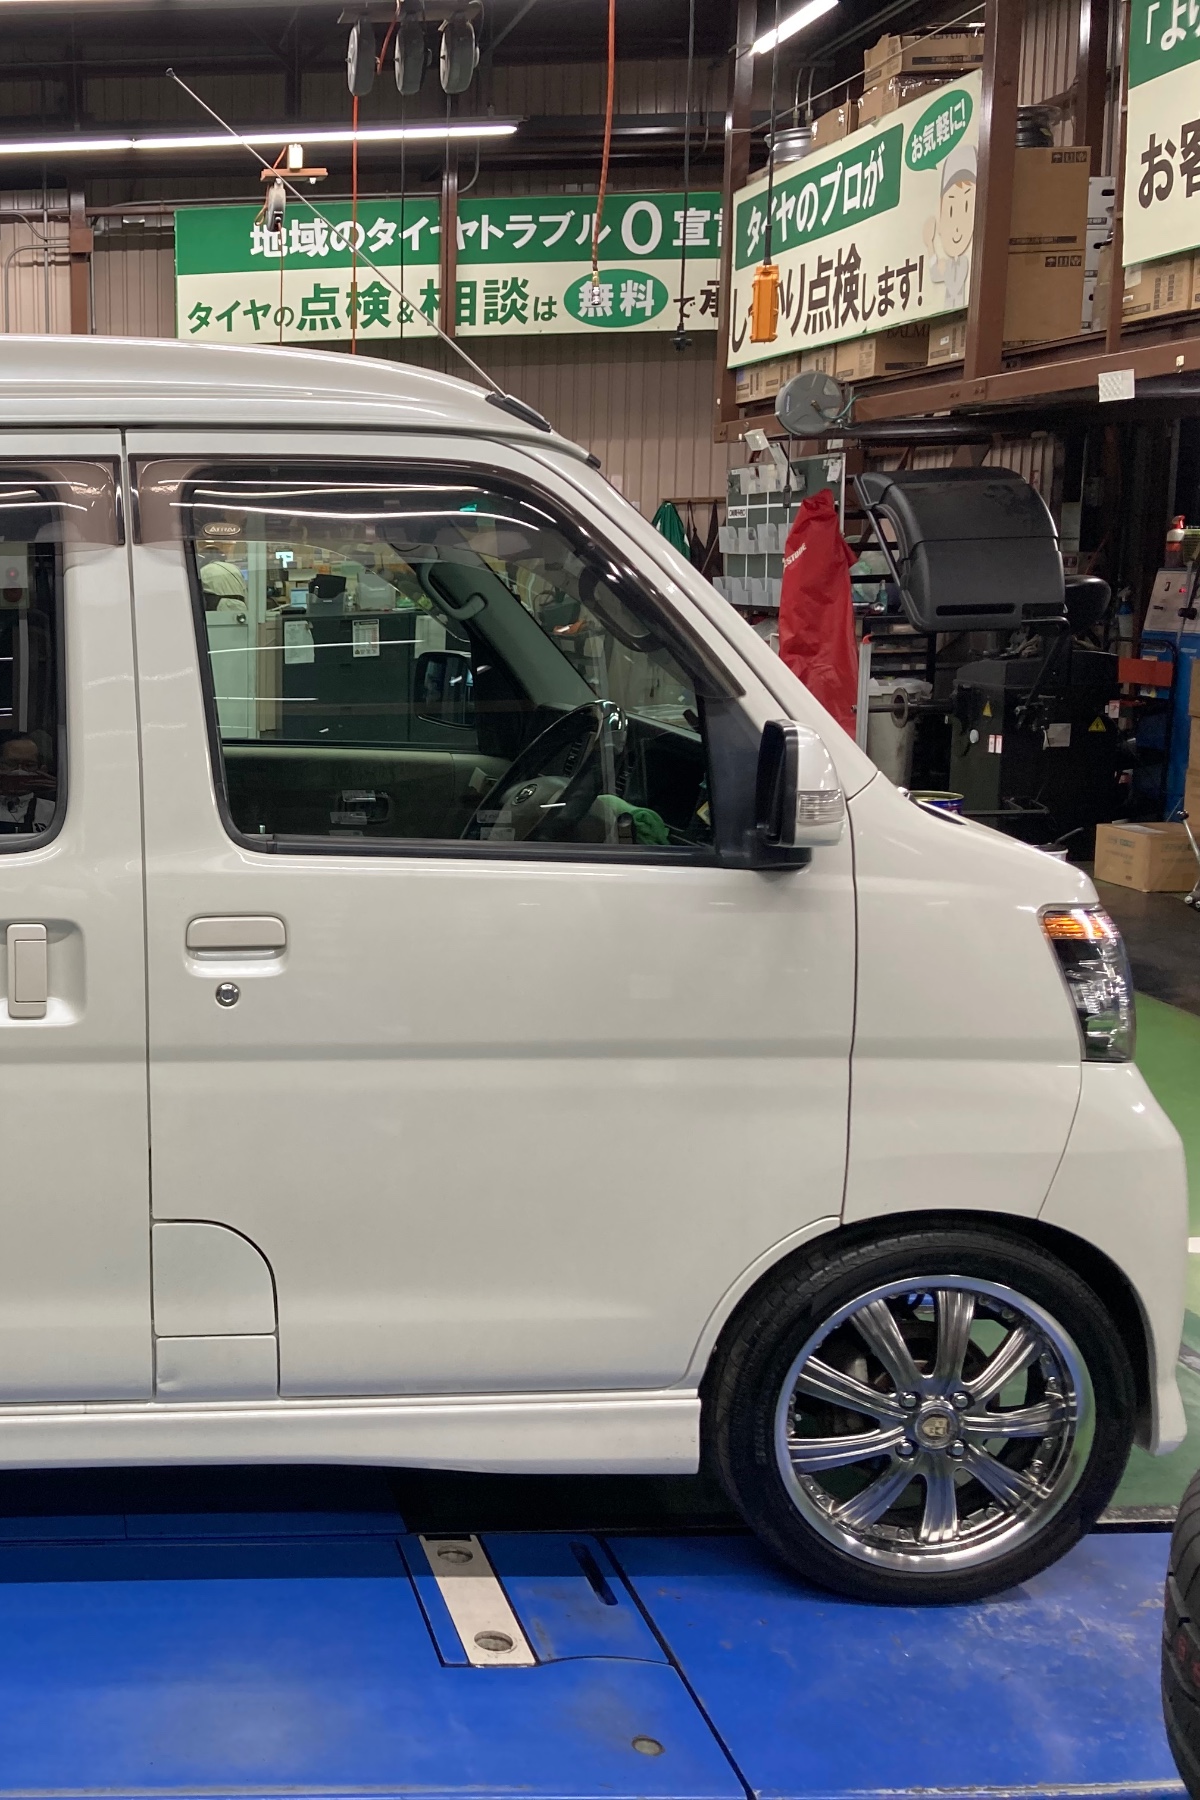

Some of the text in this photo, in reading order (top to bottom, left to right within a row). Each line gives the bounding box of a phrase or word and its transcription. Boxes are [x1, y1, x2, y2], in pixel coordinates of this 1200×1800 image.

[911, 98, 966, 163] お気軽に!
[250, 200, 723, 258] 地域のタイヤトラブル0宣
[746, 141, 885, 257] タイヤのプロが
[731, 243, 925, 353] しり点検します!
